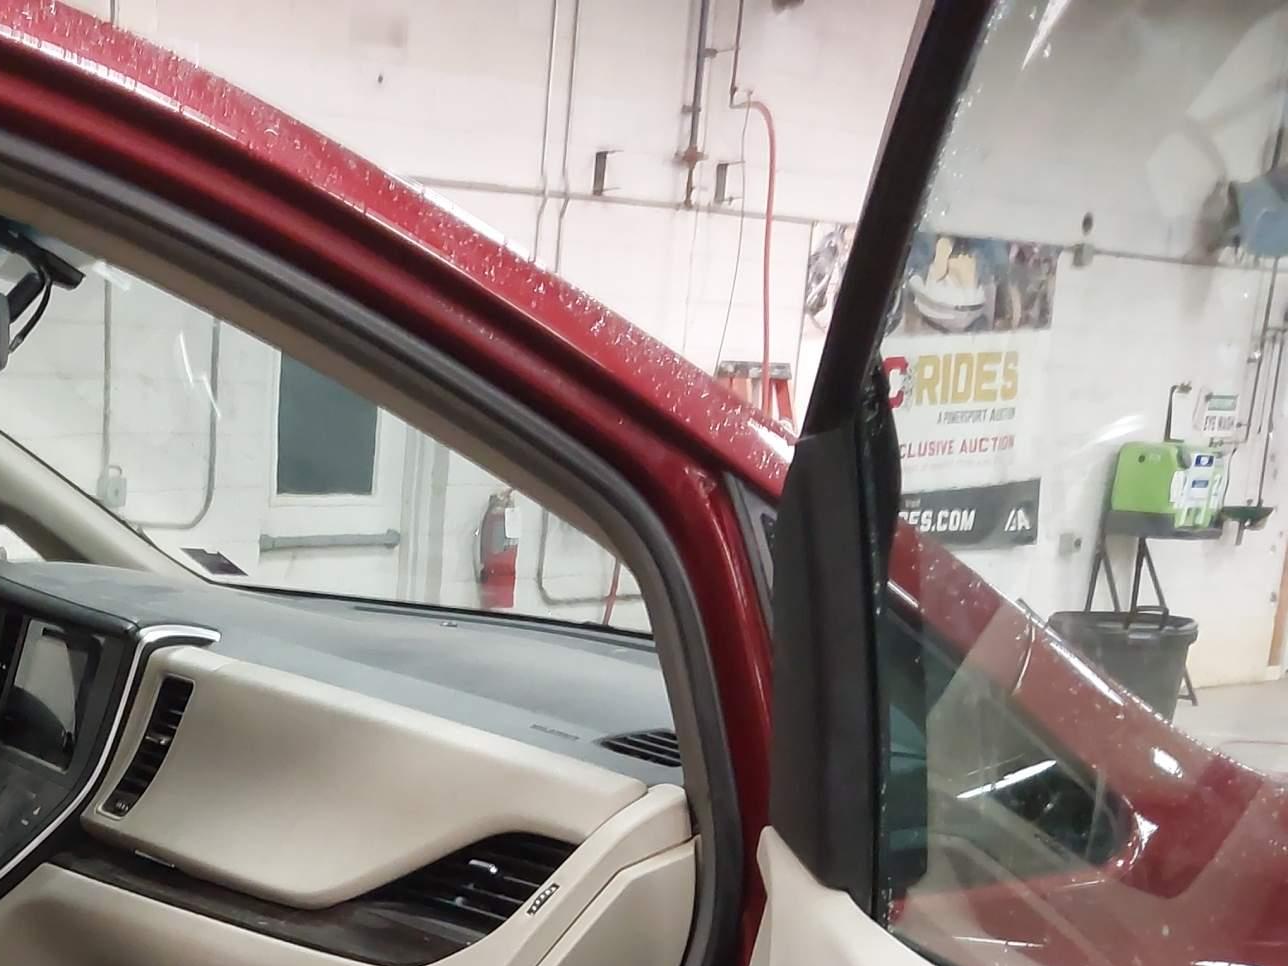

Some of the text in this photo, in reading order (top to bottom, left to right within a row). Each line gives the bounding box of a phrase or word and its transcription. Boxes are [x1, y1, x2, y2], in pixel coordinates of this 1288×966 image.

[915, 351, 1019, 406] RIDES
[900, 434, 1016, 459] CLUSIVE AUCTION
